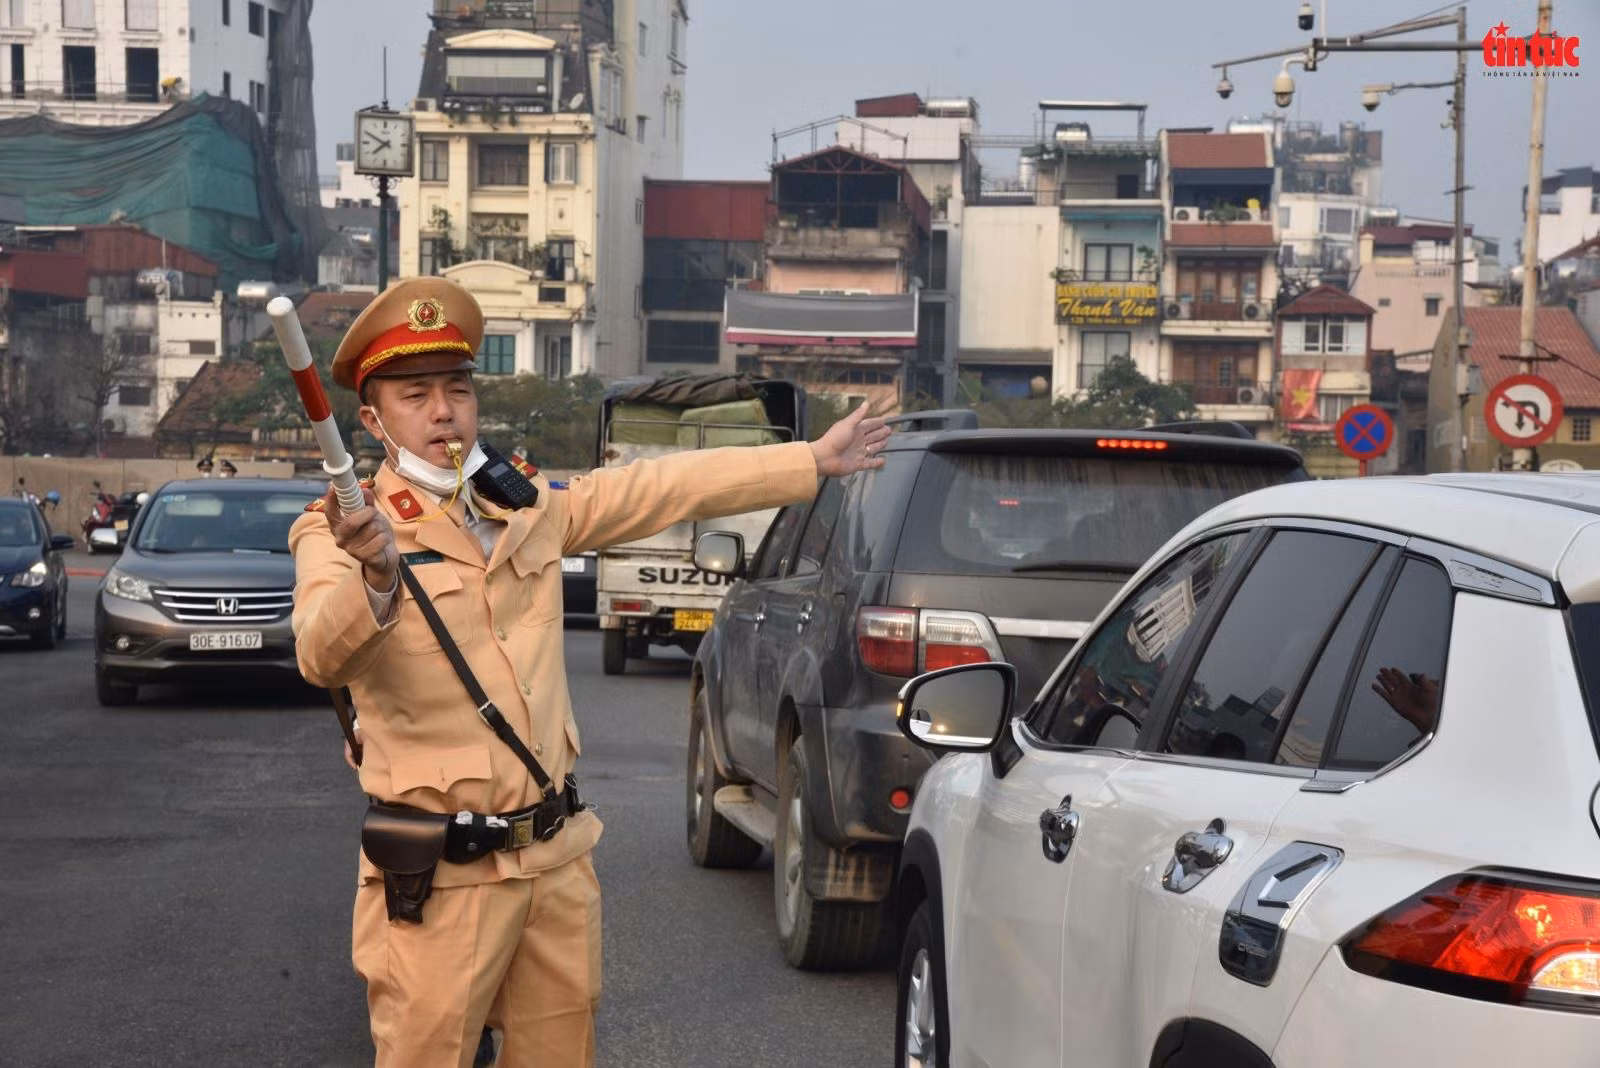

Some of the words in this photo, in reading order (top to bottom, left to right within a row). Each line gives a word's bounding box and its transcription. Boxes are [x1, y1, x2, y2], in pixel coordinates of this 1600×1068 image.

[1057, 298, 1113, 316] Thanh
[638, 567, 736, 586] SUZU
[192, 634, 260, 649] 30E-916.07
